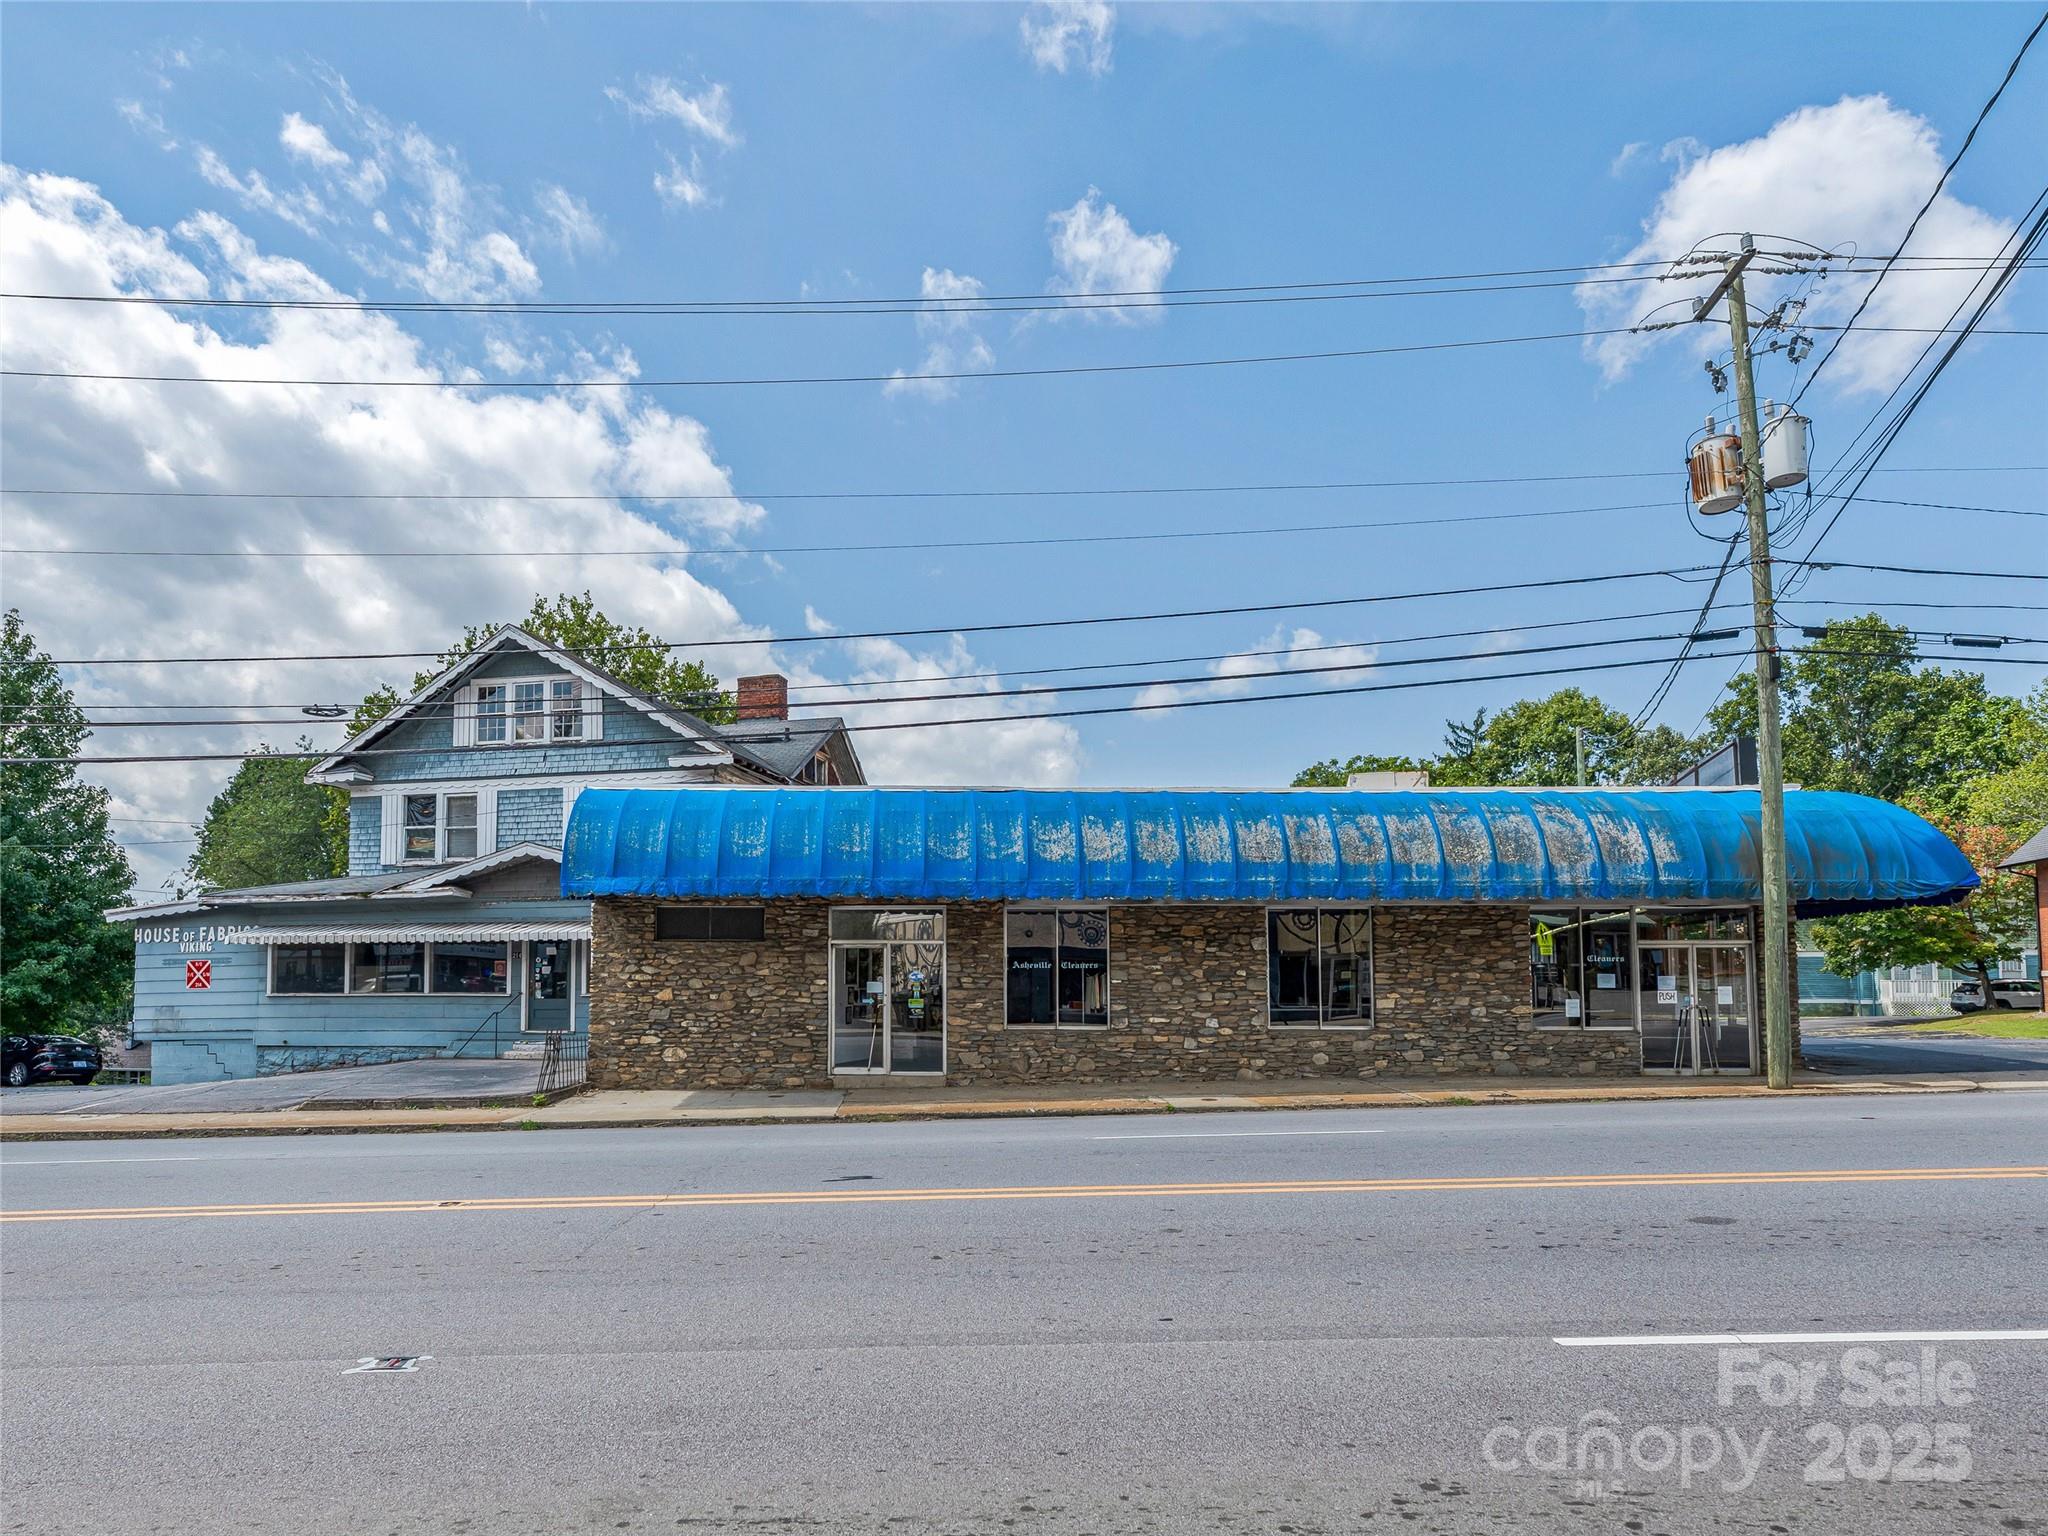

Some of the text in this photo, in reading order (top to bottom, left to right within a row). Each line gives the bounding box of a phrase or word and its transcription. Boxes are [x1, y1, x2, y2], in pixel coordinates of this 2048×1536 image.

[134, 925, 260, 943] HOUSE OF FABR
[180, 941, 212, 953] VIKING
[1586, 954, 1625, 963] Cleaners
[1012, 960, 1099, 970] Asheville Cleaners
[1659, 992, 1676, 1001] PUSH
